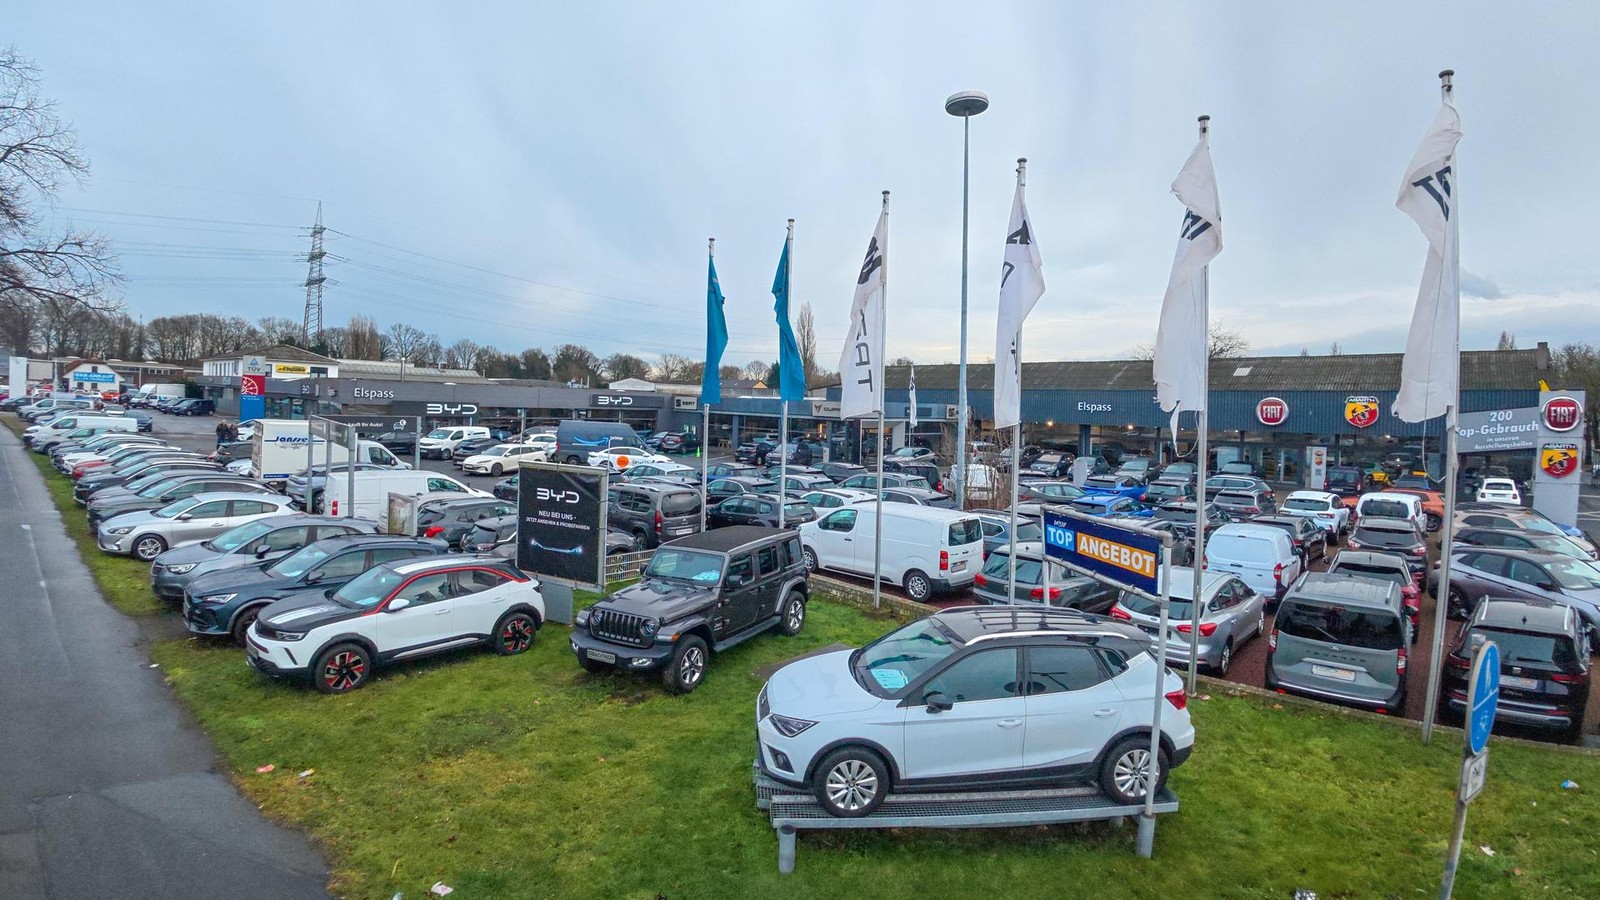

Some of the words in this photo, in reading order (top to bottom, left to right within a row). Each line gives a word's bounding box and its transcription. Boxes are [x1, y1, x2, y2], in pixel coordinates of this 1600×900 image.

[354, 388, 394, 399] Elspass
[598, 396, 632, 405] BYD
[427, 404, 477, 414] BYD
[1078, 402, 1112, 413] Elspass
[1263, 406, 1281, 418] FIAT
[1490, 411, 1513, 422] 200
[1551, 407, 1575, 422] FIAT
[537, 488, 579, 503] BYD
[560, 522, 590, 530] PROBEFAHREN
[1048, 526, 1073, 546] TOP
[1079, 536, 1155, 573] ANGEBOT
